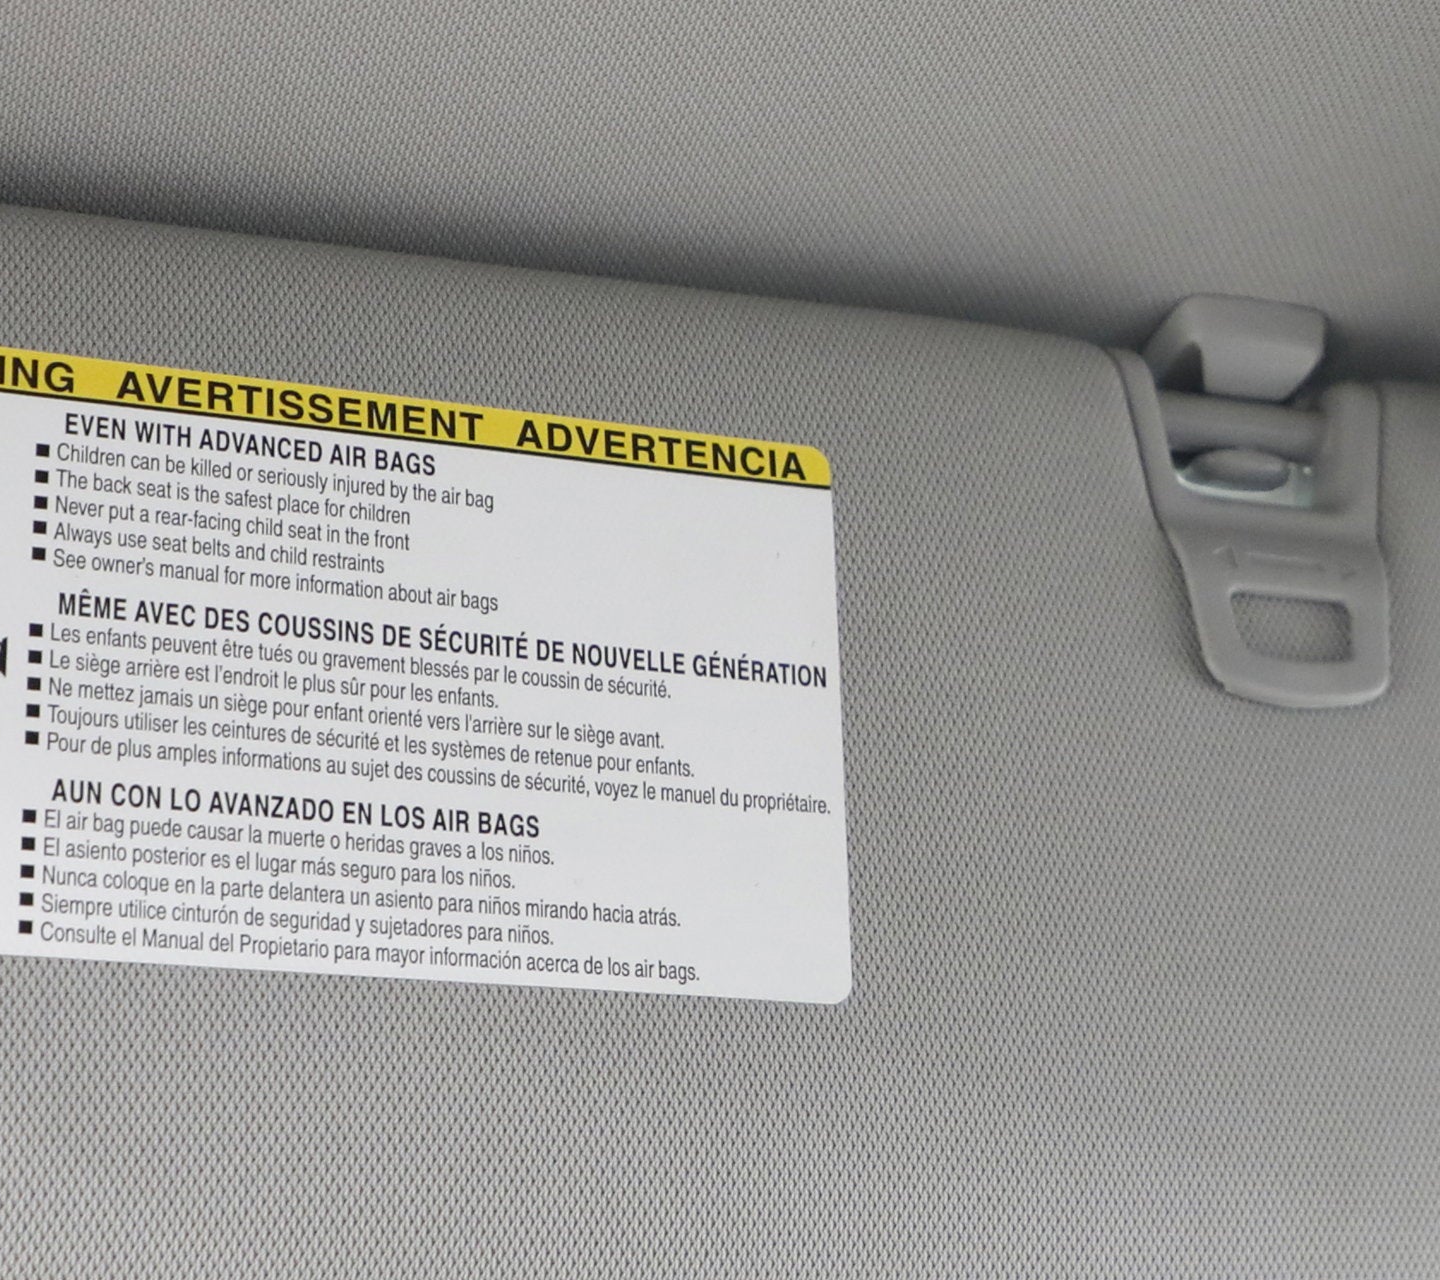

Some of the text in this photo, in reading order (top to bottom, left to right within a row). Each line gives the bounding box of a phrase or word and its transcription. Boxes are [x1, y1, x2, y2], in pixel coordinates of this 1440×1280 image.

[64, 411, 436, 477] EVEN WITH ADVANCED AIR BAGS
[116, 370, 483, 441] AVERTISSEMENT
[516, 419, 806, 480] ADVERTENCIA
[55, 467, 410, 525] The back seat is the safest place for children
[56, 441, 494, 514] Children can be killed or seriously injured by the air bag
[52, 520, 385, 574] Always use seat belts and child restraints
[54, 494, 410, 551] Never put a rear-facing child seat in the front
[52, 547, 86, 570] See
[158, 562, 219, 583] manual
[223, 564, 246, 585] for
[249, 571, 291, 590] more
[295, 572, 383, 600] information
[387, 582, 432, 605] about
[435, 587, 457, 607] air
[459, 589, 498, 615] bags
[57, 587, 827, 688] MÊME AVEC DES COUSSINS DE SÉCURITÉ DE NOUVELLE GÉNÉRATION
[48, 648, 70, 670] Le
[74, 651, 121, 678] siège
[124, 657, 180, 680] arrière
[184, 664, 210, 683] est
[282, 670, 298, 691] le
[301, 672, 336, 696] plus
[339, 675, 366, 696] sûr
[369, 682, 406, 702] pour
[410, 681, 433, 703] les
[437, 685, 498, 708] enfants.
[48, 675, 73, 698] Ne
[77, 682, 134, 703] mettez
[137, 684, 193, 708] jamais
[198, 693, 219, 710] un
[223, 692, 268, 719] siège
[271, 700, 310, 720] pour
[313, 701, 364, 723] enfant
[367, 705, 423, 728] orienté
[426, 714, 460, 732] vers
[526, 722, 552, 739] sur
[555, 720, 570, 741] le
[573, 723, 615, 749] siège
[618, 730, 664, 749] avant.
[46, 730, 831, 814] Pour de plus amples informations au sujet des coussins de sécurité, voyez le manuel du propriétaire.
[50, 777, 540, 838] AUN CON LO AVANZADO EN LOS AIR BAGS
[42, 835, 515, 889] El asiento posterior es el lugar más seguro para los niños.
[40, 892, 554, 945] Siempre utilice cinturón de seguridad y sujetadores para niños.
[41, 864, 681, 927] Nunca coloque en la parte delantera un asiento para niños mirando hacia atrás.
